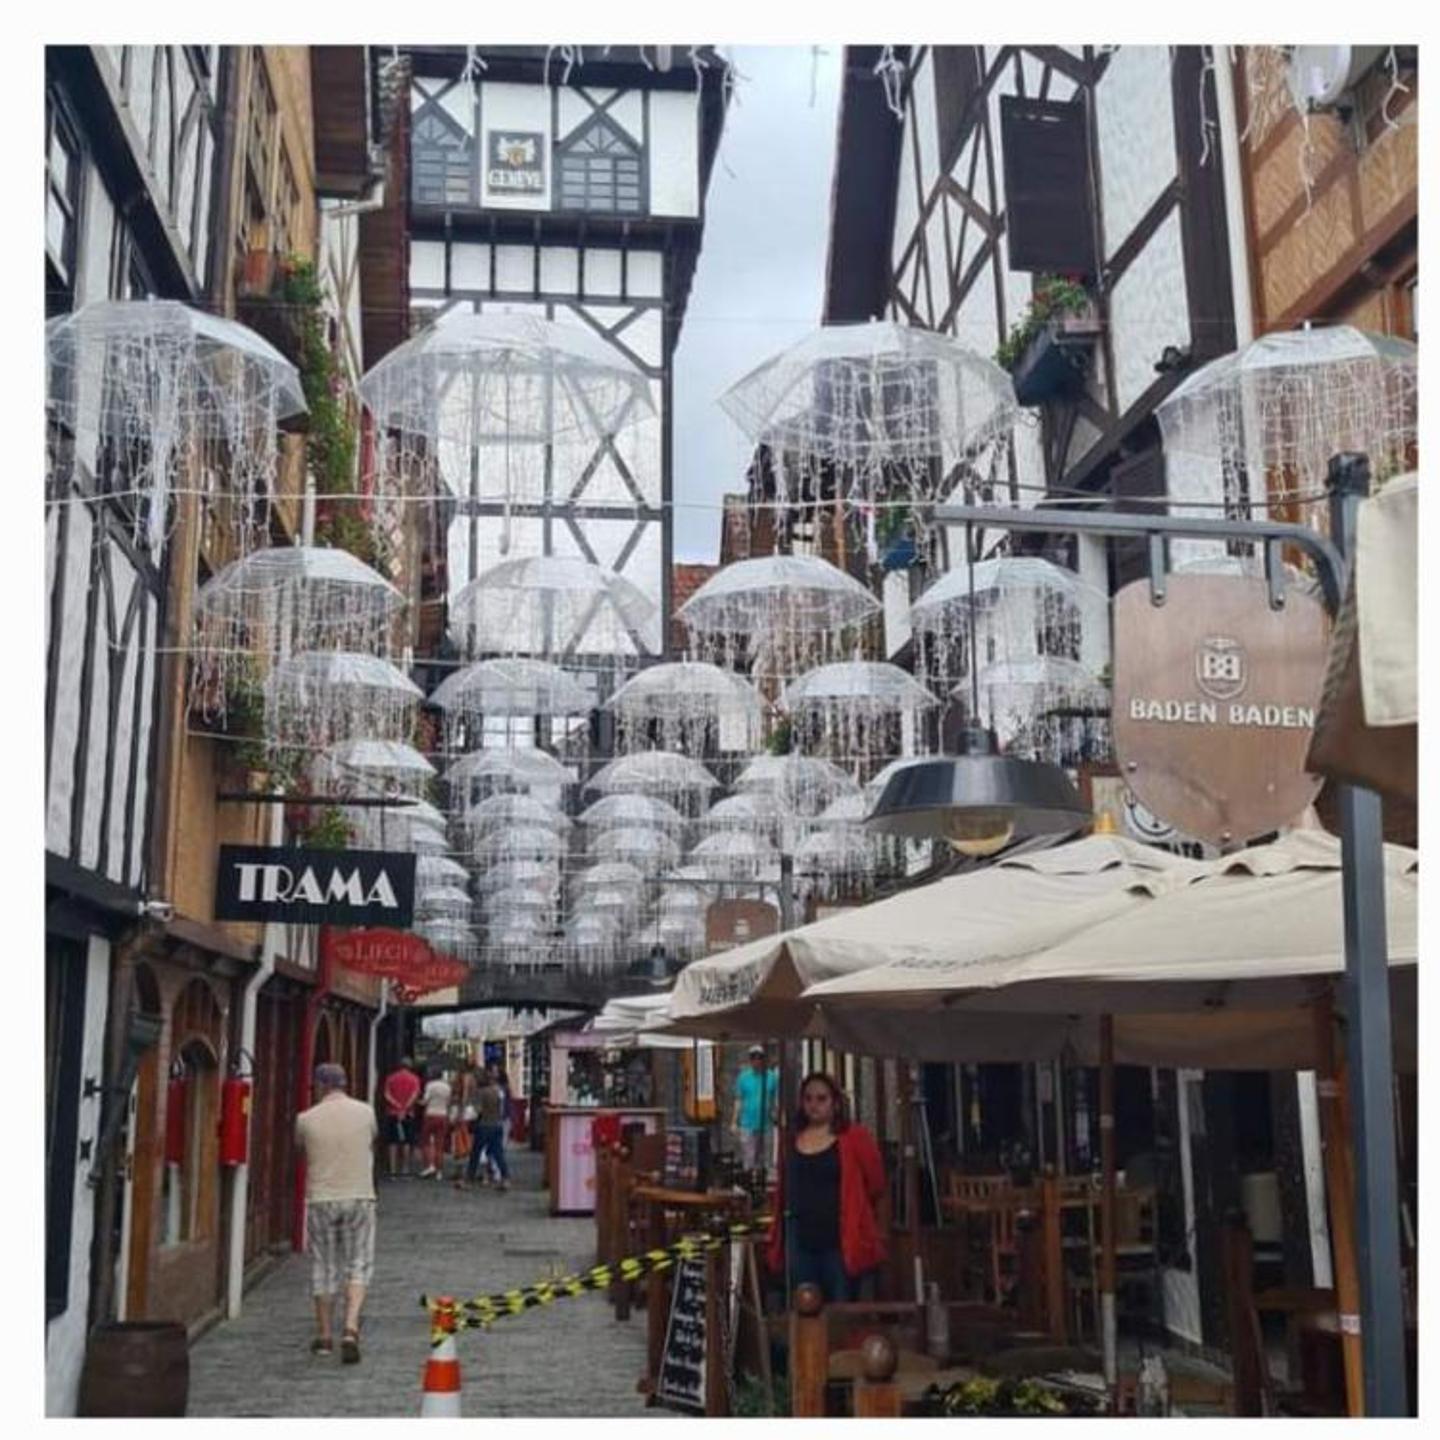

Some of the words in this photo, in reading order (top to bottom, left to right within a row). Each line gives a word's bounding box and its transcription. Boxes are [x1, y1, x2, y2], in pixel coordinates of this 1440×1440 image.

[1130, 700, 1217, 724] BADEN
[1229, 704, 1315, 729] BADEN
[233, 863, 399, 909] TRAMA
